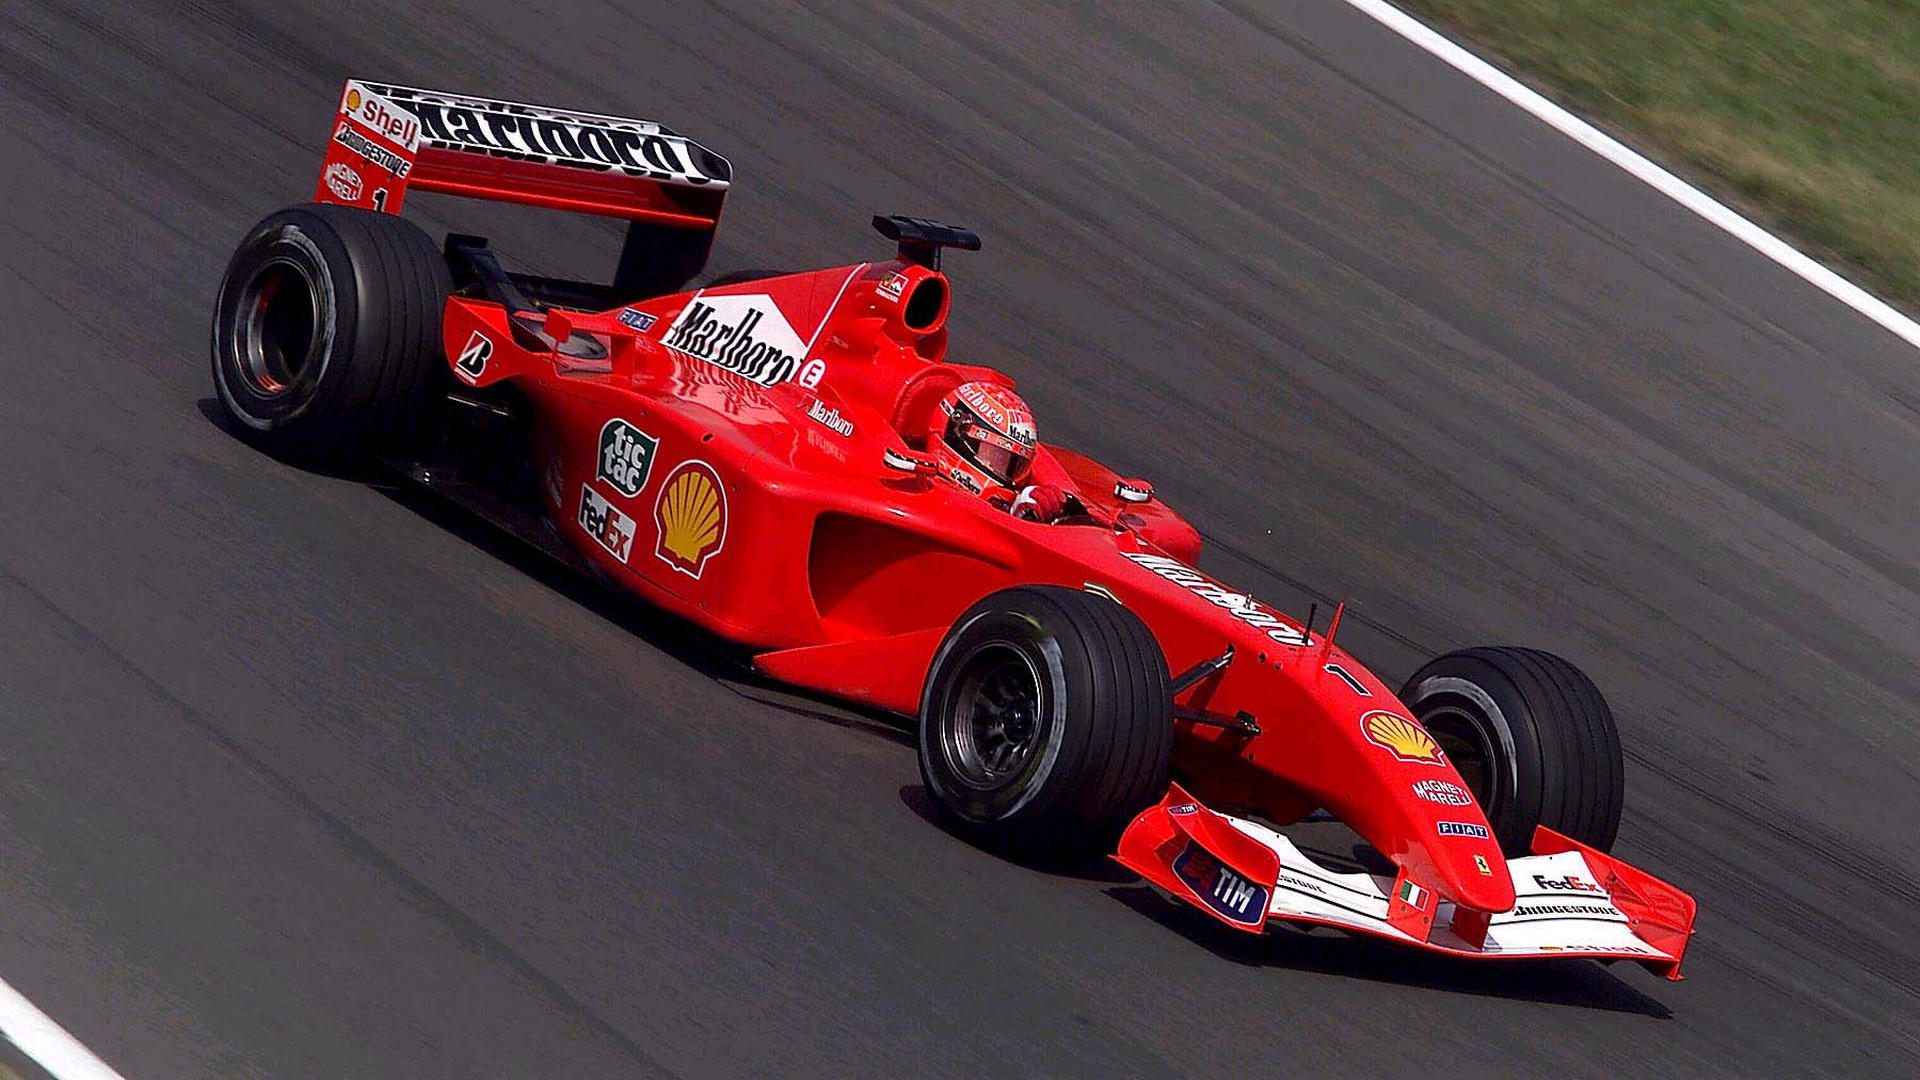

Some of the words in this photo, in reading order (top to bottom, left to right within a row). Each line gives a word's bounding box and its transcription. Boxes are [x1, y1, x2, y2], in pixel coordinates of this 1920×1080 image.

[362, 99, 418, 146] Shell
[373, 188, 388, 211] 1
[618, 309, 656, 330] FIAT
[668, 300, 795, 387] Marlboro
[803, 363, 822, 386] E
[807, 400, 854, 437] Marlboro
[958, 383, 1004, 424] arlboro
[614, 424, 645, 470] tic
[604, 443, 640, 492] tac
[580, 486, 630, 561] FedEx
[1323, 663, 1373, 697] 1
[1439, 823, 1487, 837] FIAT
[1213, 867, 1256, 914] TIM
[1532, 875, 1603, 892] FedEx
[1513, 905, 1619, 917] BRIDGESTONE
